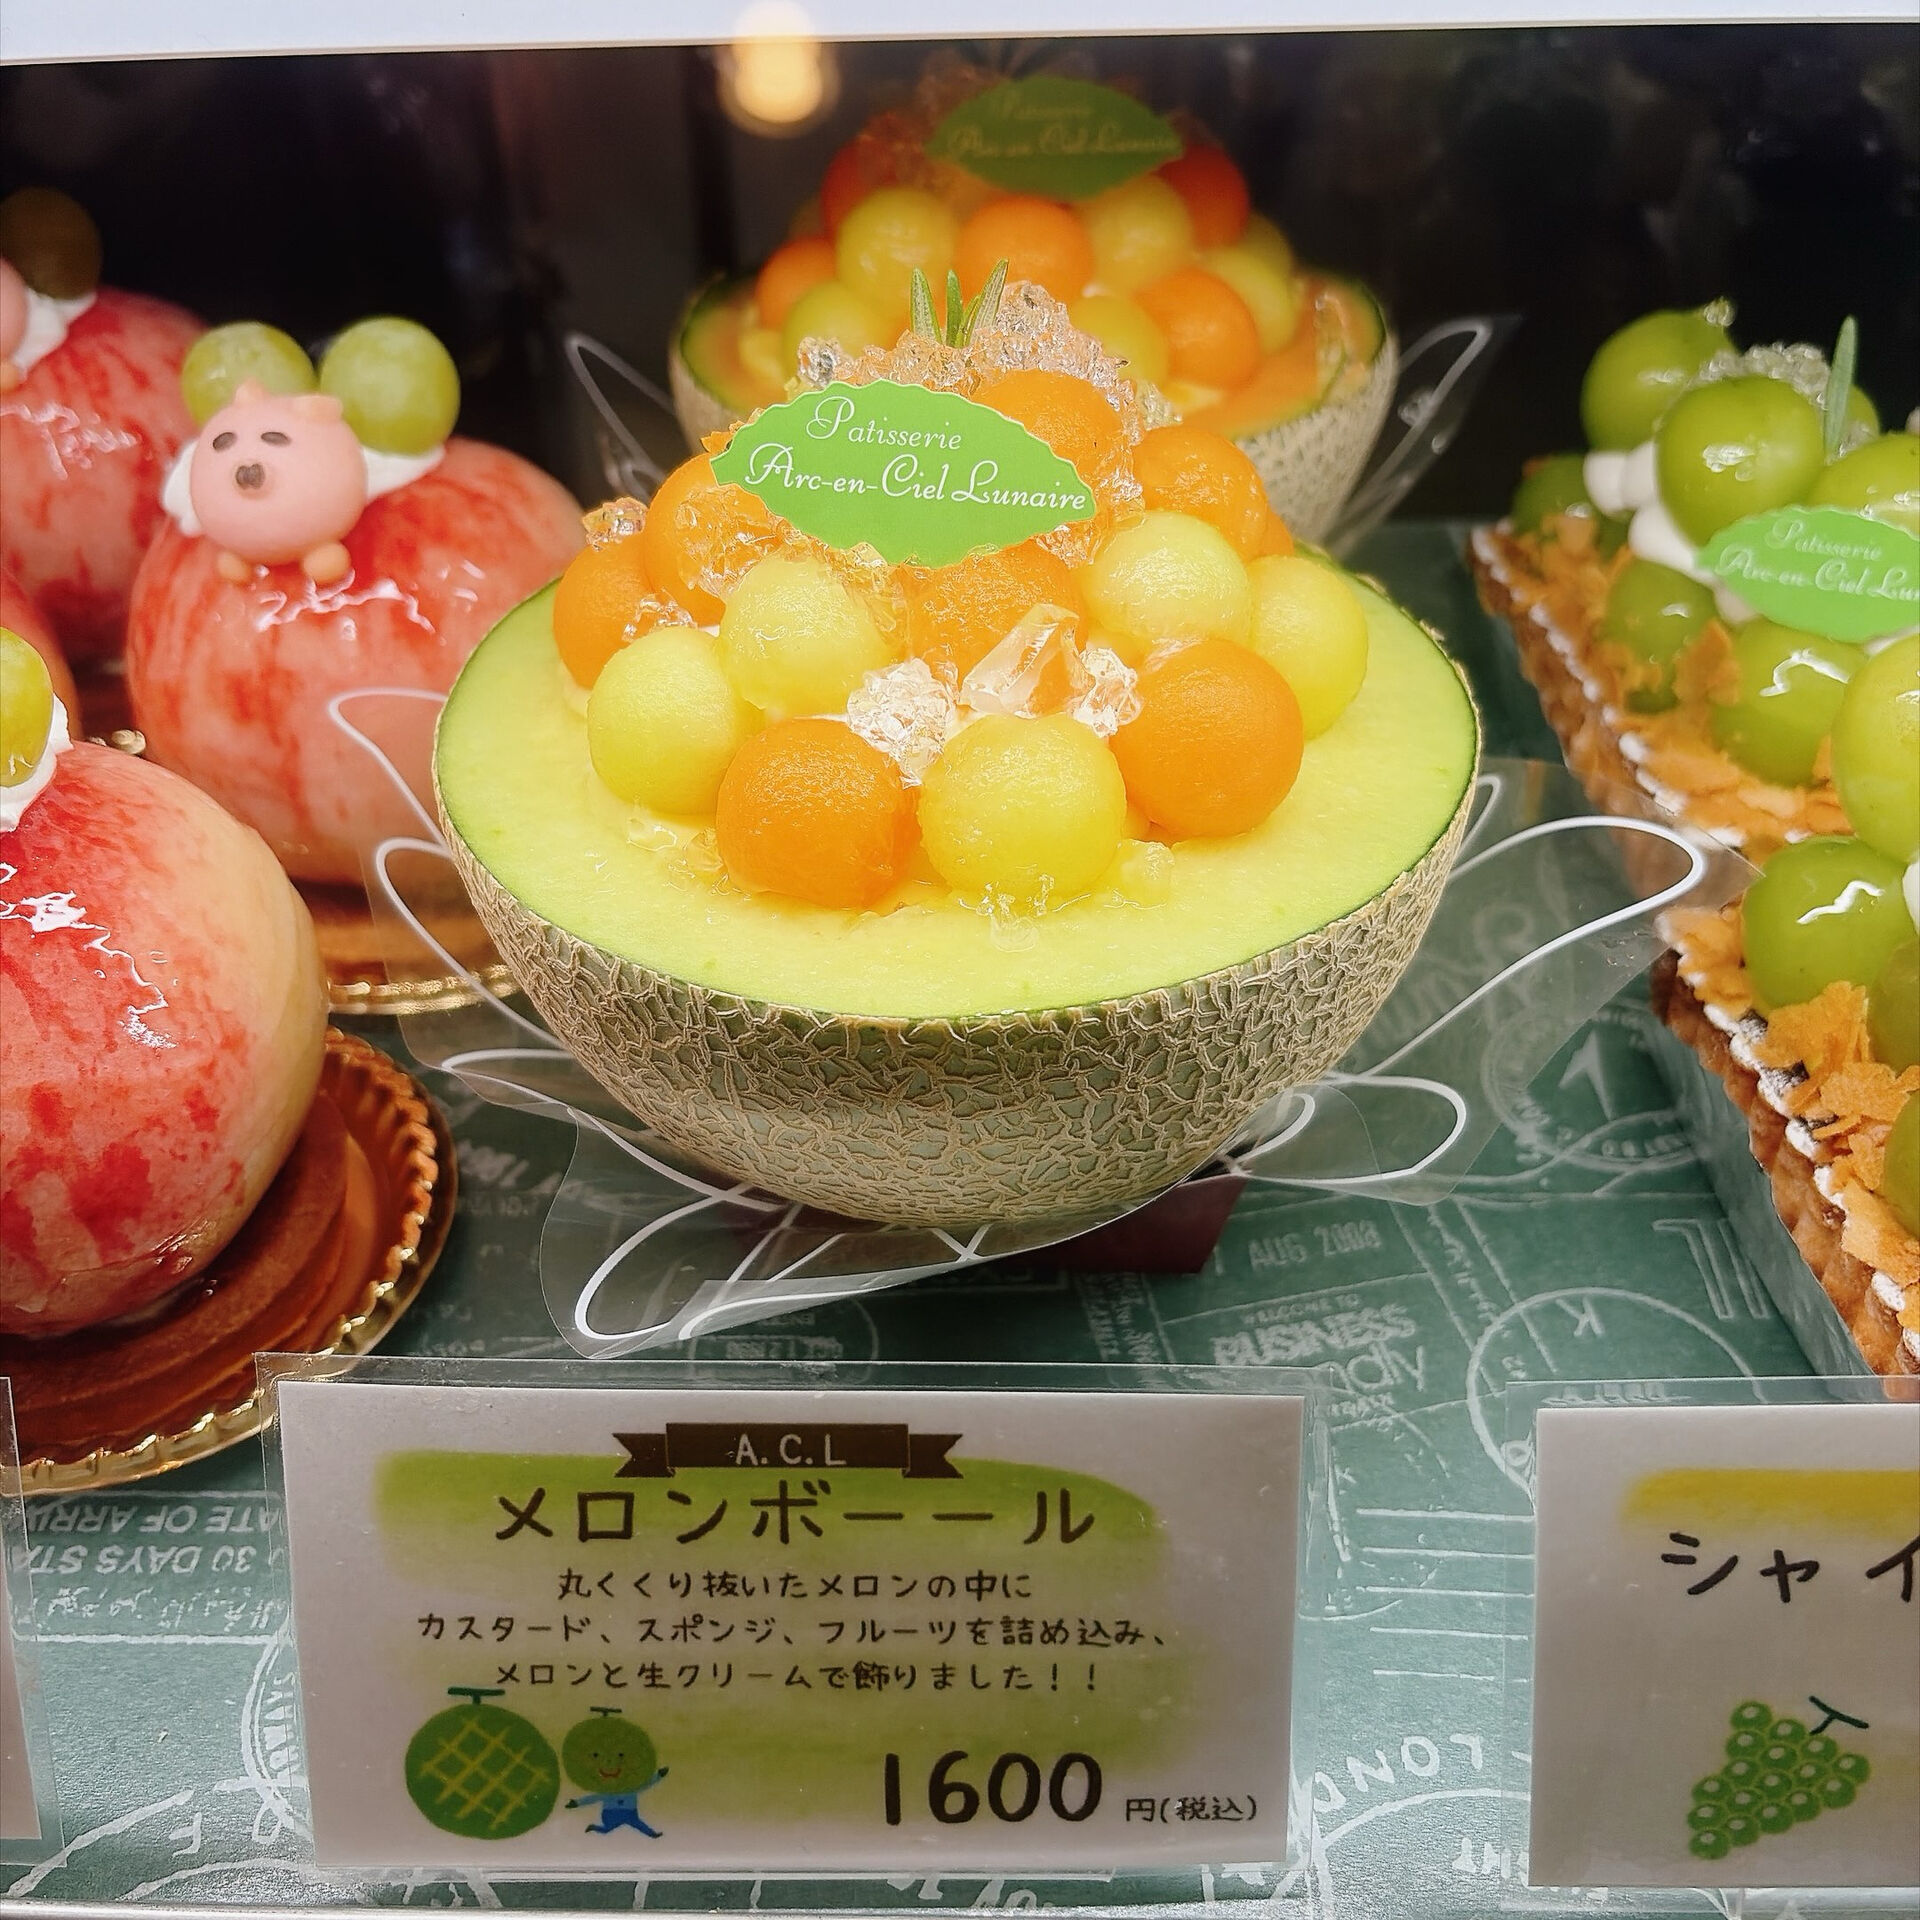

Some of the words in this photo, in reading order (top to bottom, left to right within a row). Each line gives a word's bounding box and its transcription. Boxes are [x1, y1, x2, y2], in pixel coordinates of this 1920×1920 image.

[805, 396, 962, 450] Patisserie
[744, 442, 949, 501] Arc-en-Ciel
[951, 459, 1087, 511] Lunaire
[735, 1433, 847, 1466] A.C.L
[138, 1504, 198, 1534] OF
[95, 1543, 203, 1575] DAYS
[211, 1544, 257, 1574] 30
[1661, 1532, 1920, 1602] シャイ
[557, 1567, 1032, 1602] 丸くくり抜いたメロンの中に
[417, 1612, 1164, 1648] カスタード、スポンジ、フルーツを詰め込み、
[884, 1750, 1103, 1826] 1600
[1125, 1795, 1258, 1823] 円(税込)
